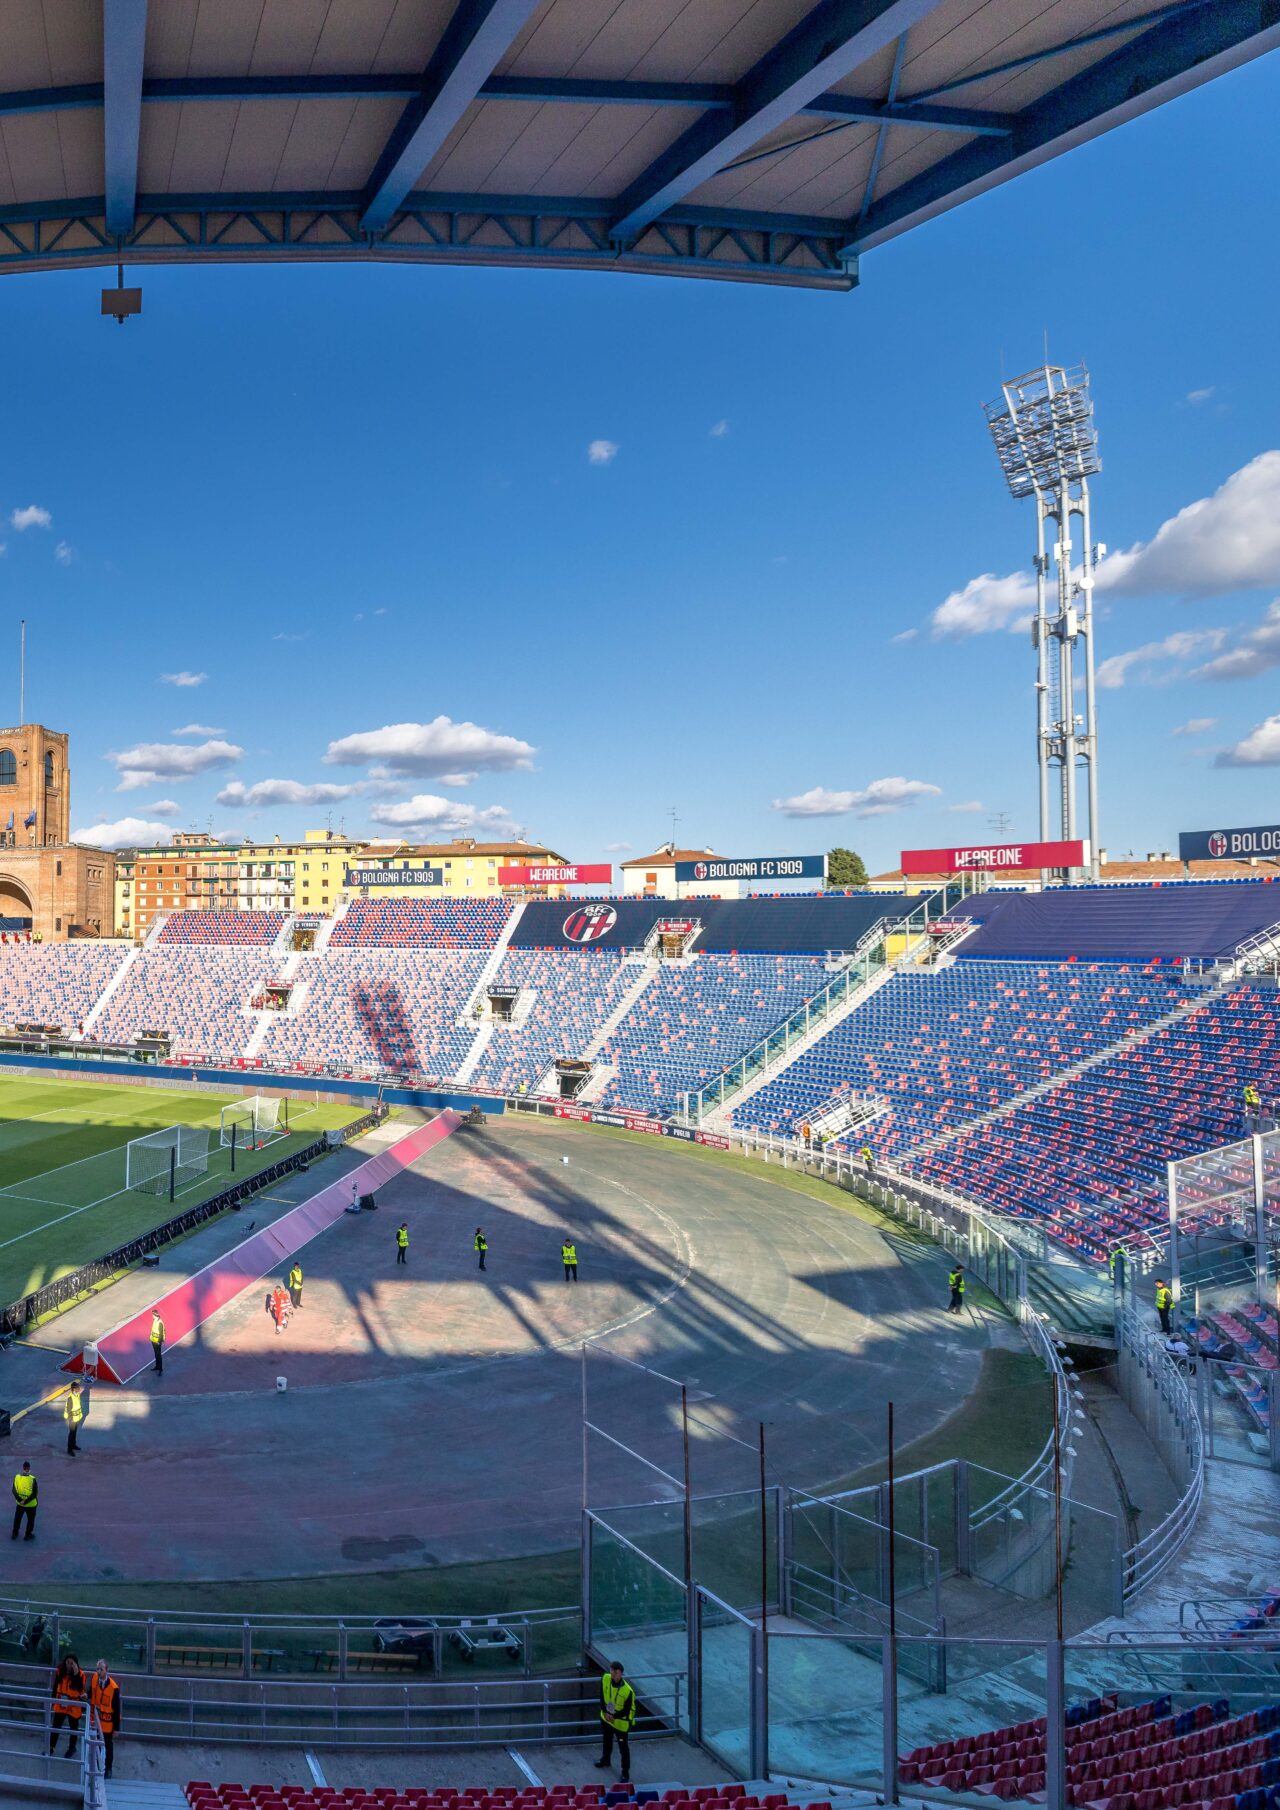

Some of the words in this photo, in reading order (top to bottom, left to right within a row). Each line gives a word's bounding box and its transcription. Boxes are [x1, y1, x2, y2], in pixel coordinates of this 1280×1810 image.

[530, 868, 578, 881] WEAREONE
[710, 862, 757, 877] BOLOGNA
[761, 862, 774, 875] FC
[776, 861, 802, 874] 1909
[362, 872, 399, 883] BOLOGNA
[401, 872, 412, 883] FC
[414, 872, 434, 882] 1909
